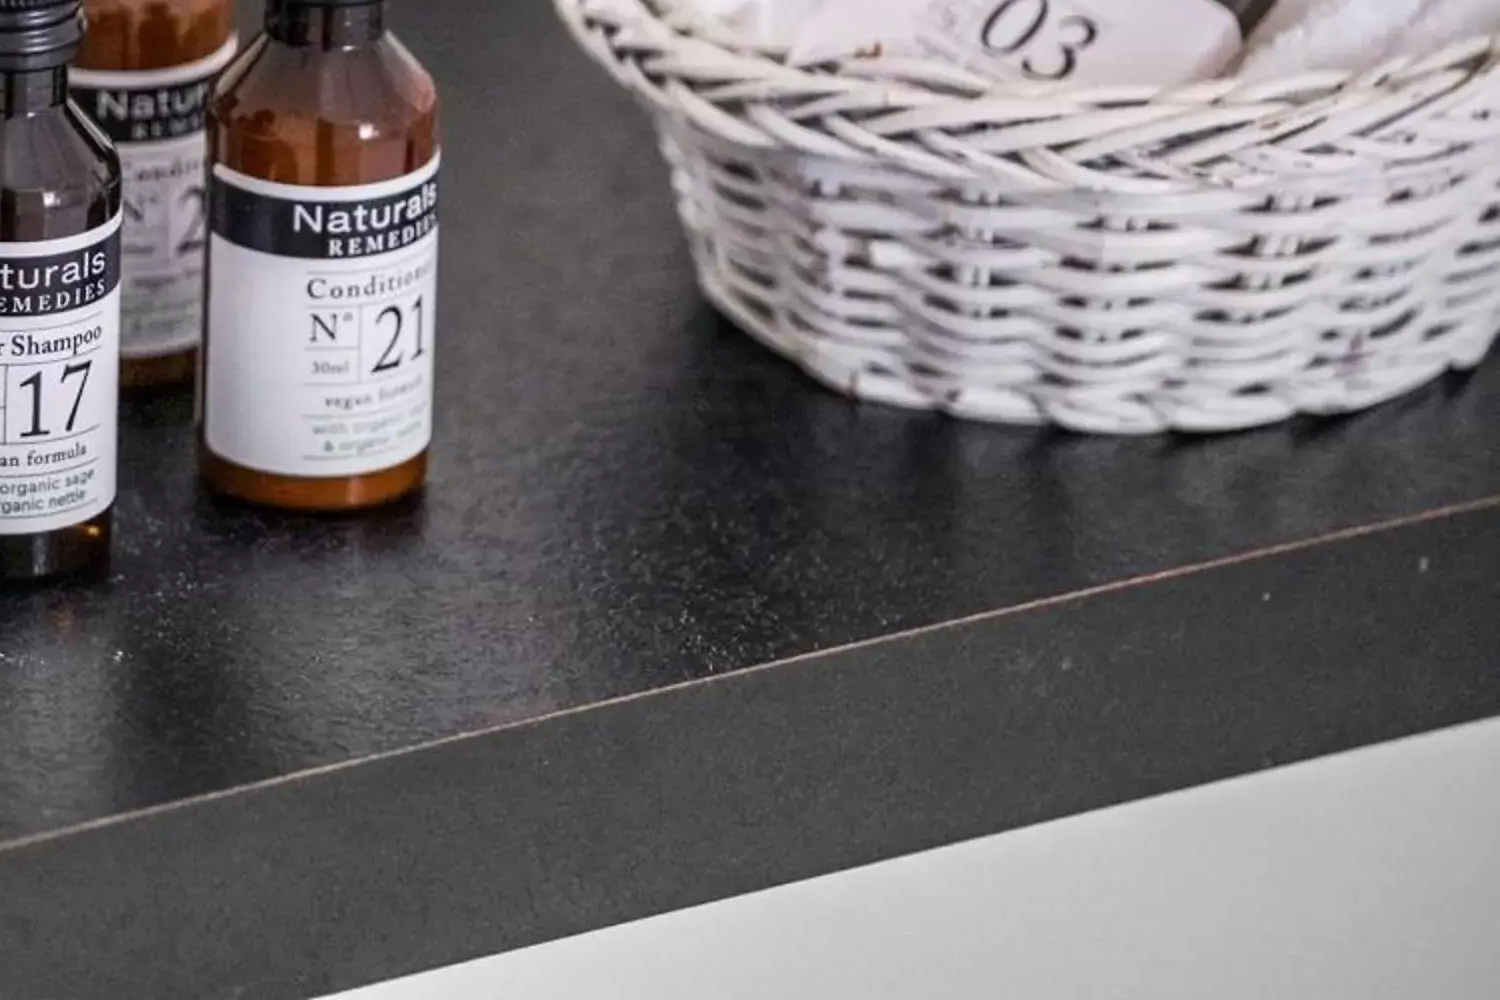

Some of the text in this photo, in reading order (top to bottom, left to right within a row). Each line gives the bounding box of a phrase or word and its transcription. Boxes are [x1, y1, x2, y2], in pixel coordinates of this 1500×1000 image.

[293, 182, 437, 234] Naturals
[10, 325, 102, 357] Shampoo
[370, 294, 425, 374] 21
[19, 359, 94, 438] 17
[26, 442, 87, 467] formula
[0, 478, 61, 497] organic
[65, 469, 95, 487] sage
